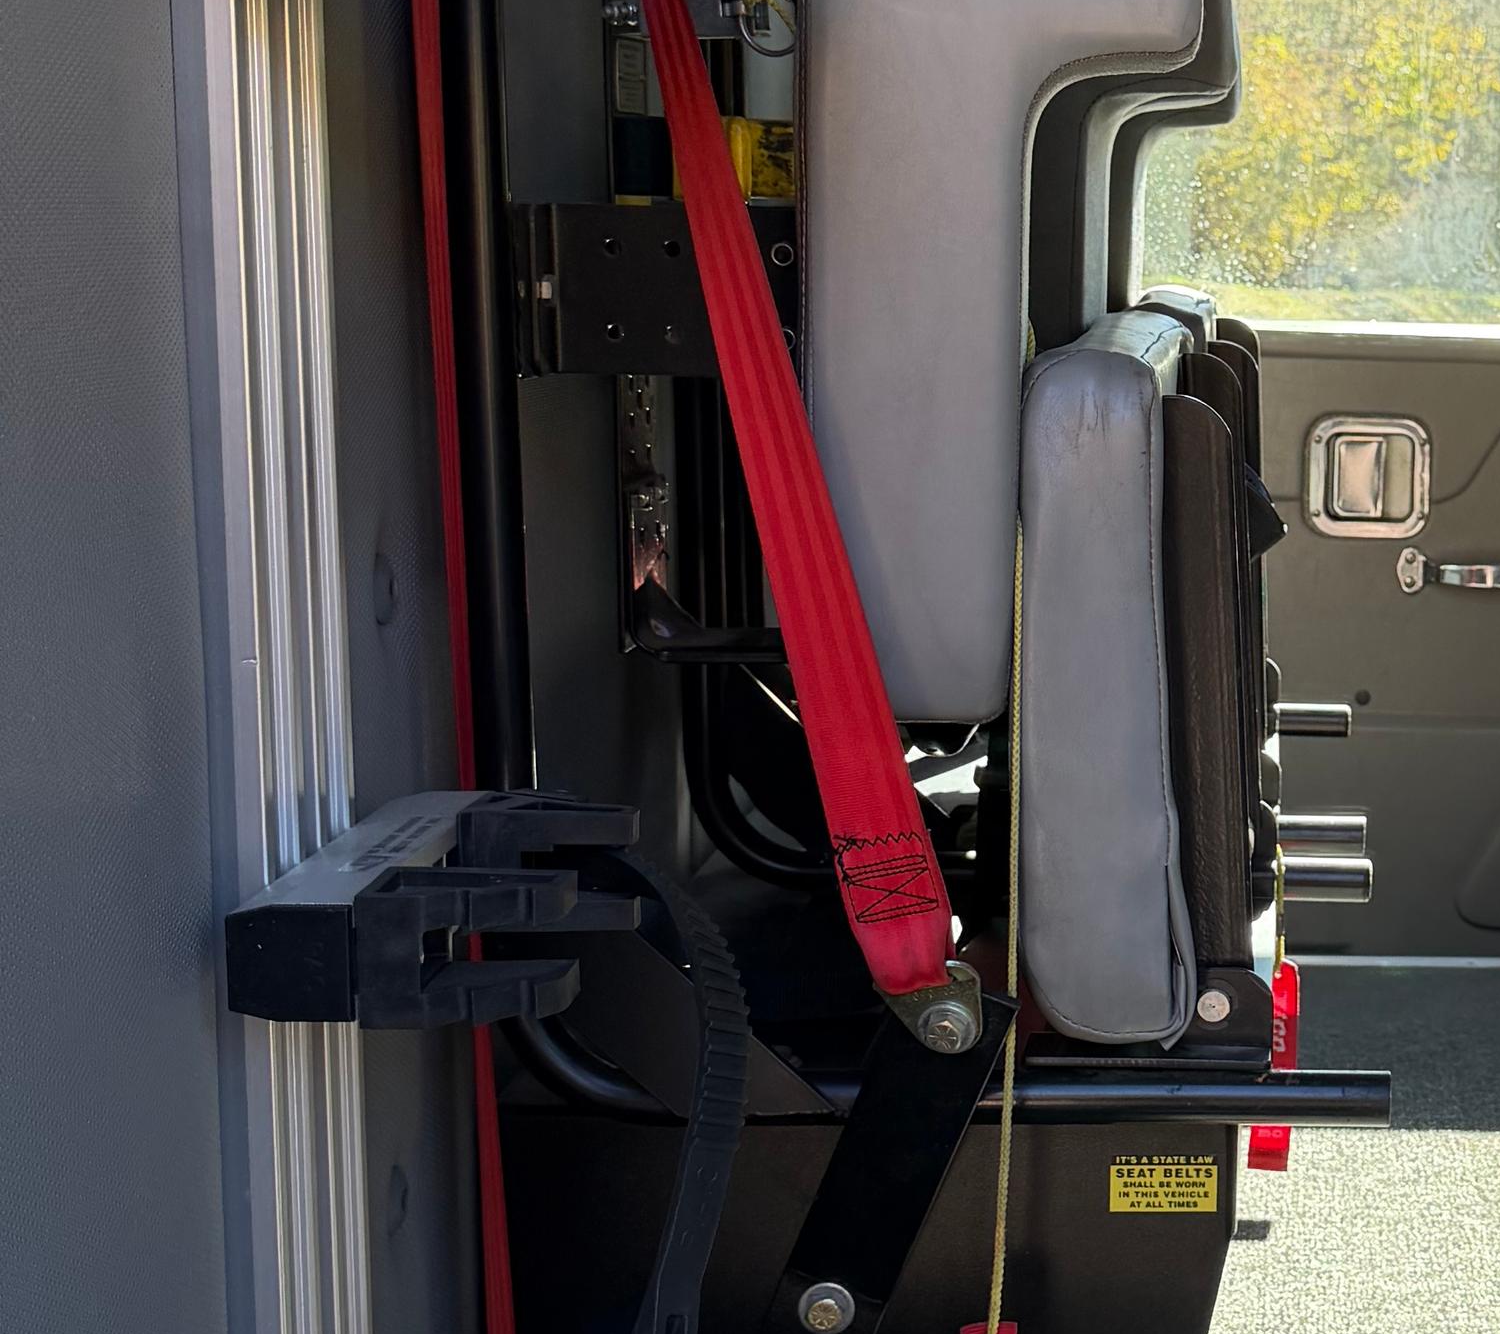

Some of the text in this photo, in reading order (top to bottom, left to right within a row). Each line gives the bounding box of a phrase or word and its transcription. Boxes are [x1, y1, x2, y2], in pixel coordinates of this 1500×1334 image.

[1115, 1155, 1214, 1164] IT'S A STATE LAW
[1115, 1168, 1213, 1178] SEAT BELTS
